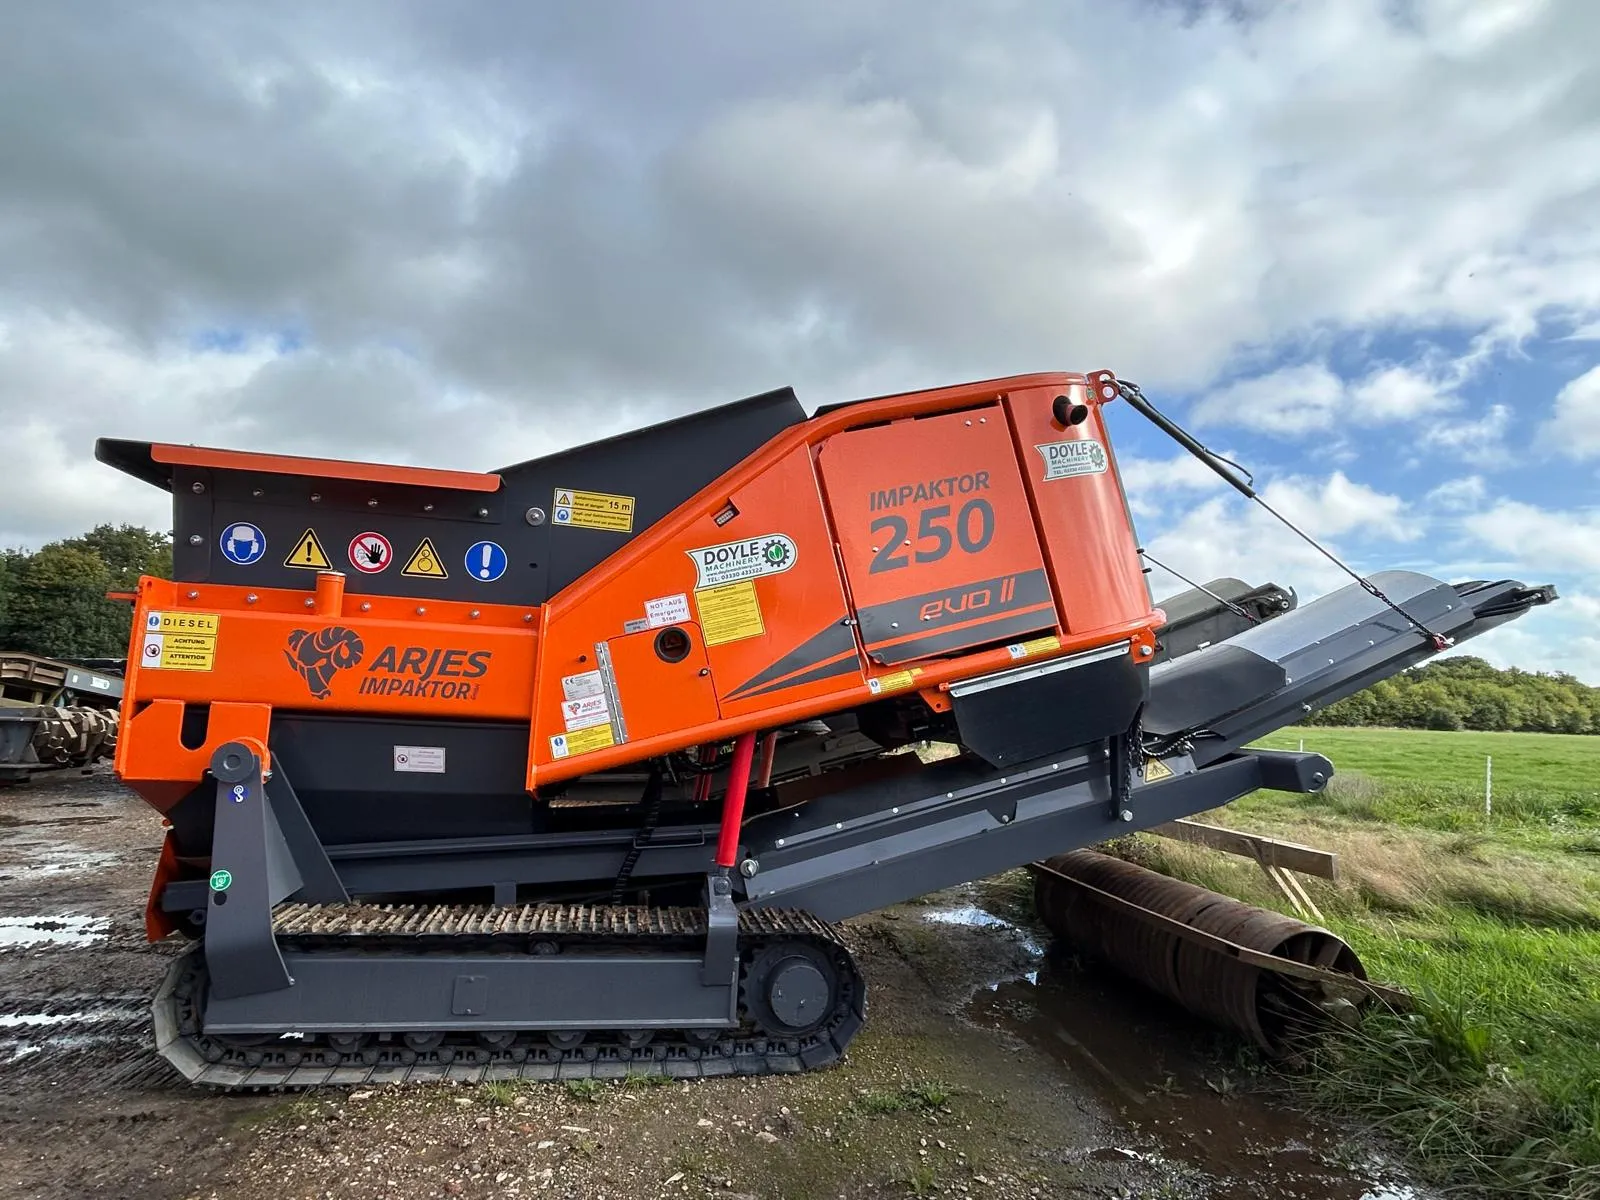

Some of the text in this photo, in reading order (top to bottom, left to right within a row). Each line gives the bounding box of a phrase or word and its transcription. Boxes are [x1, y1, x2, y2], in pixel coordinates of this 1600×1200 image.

[1049, 443, 1088, 459] DOYLE
[1051, 456, 1089, 465] MACHINERY
[869, 471, 991, 512] IMPAKTOR
[609, 501, 619, 510] 15
[869, 498, 995, 575] 250
[704, 542, 759, 565] DOYLE
[705, 556, 760, 572] MACHINERY
[650, 599, 682, 610] NOT-AUS
[650, 607, 686, 618] Emergency
[919, 589, 991, 622] evo
[163, 618, 213, 629] DIESEL
[368, 646, 492, 680] ARJES
[359, 677, 471, 700] IMPAKTOR
